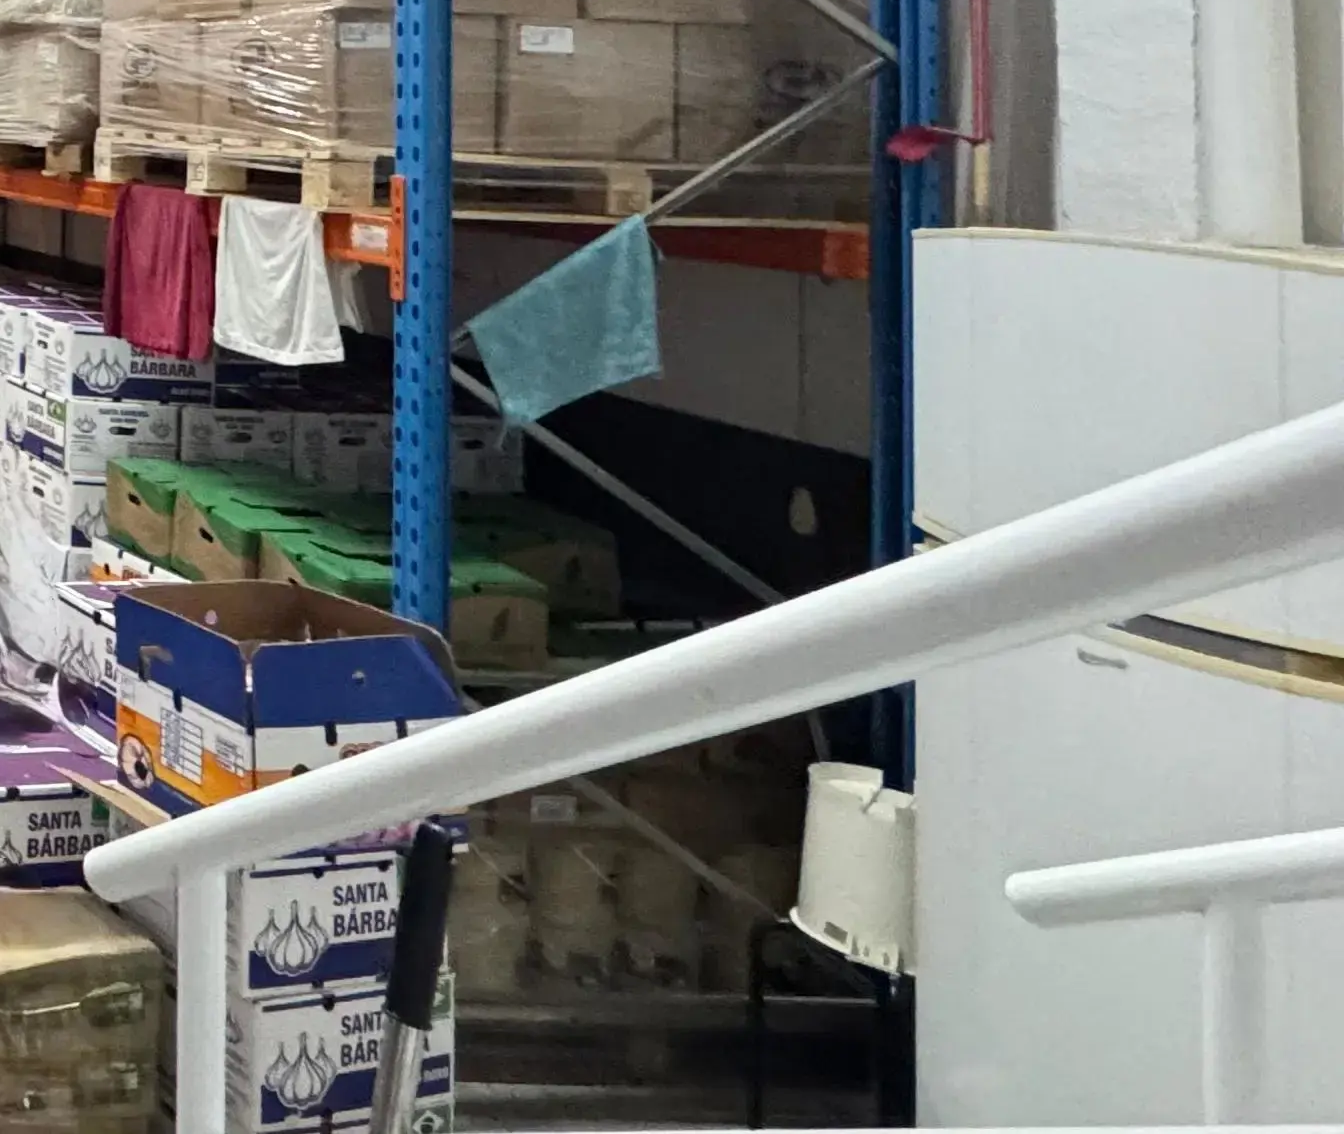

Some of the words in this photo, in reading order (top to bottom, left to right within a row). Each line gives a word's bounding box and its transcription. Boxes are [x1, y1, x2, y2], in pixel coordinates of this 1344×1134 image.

[27, 811, 82, 832] SANTA
[26, 834, 106, 858] BÁRBAR
[333, 882, 389, 907] SANTA
[333, 908, 398, 938] BÁRBA
[340, 1012, 382, 1037] SANT
[340, 1035, 380, 1067] BÁR
